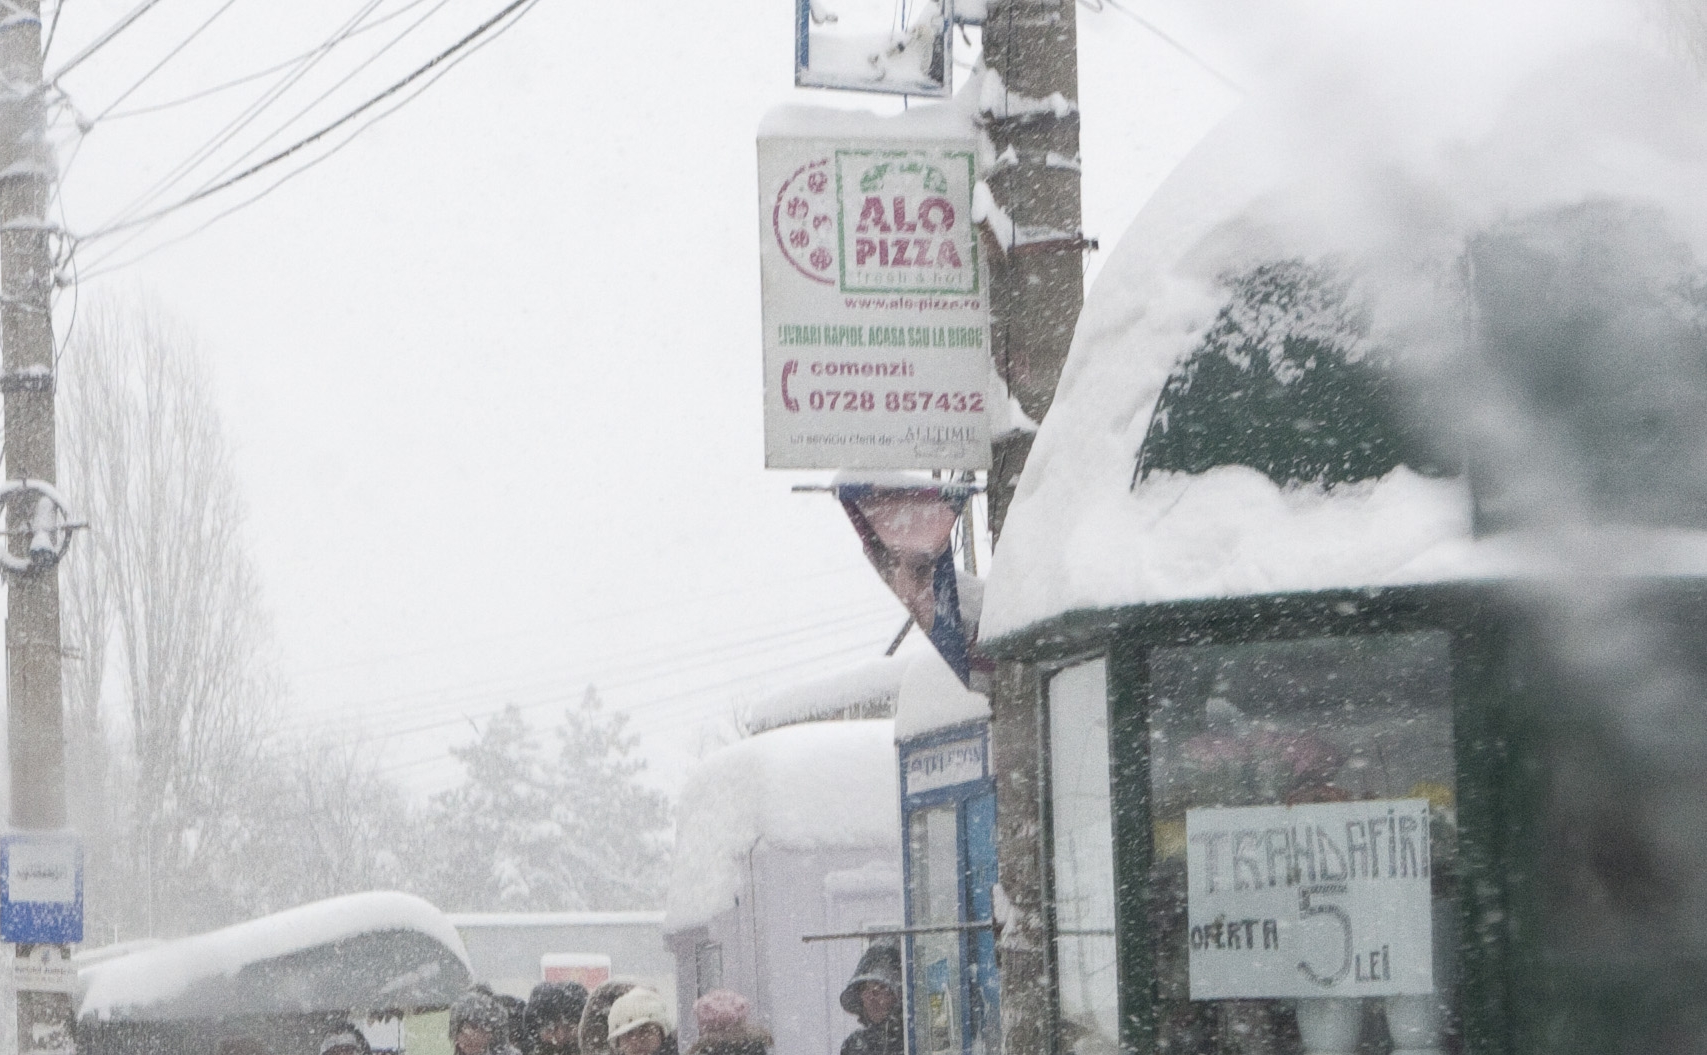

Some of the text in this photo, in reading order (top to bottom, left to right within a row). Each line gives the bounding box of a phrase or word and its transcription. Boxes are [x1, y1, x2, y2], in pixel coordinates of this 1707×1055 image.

[856, 196, 955, 234] ALO
[856, 238, 962, 269] PIZZA
[868, 325, 906, 347] ACASA
[932, 326, 945, 347] LA
[809, 391, 985, 413] 0728 857432
[1191, 808, 1430, 893] TRANDAFIRI
[1192, 884, 1391, 987] OFERTA 5 LEI
